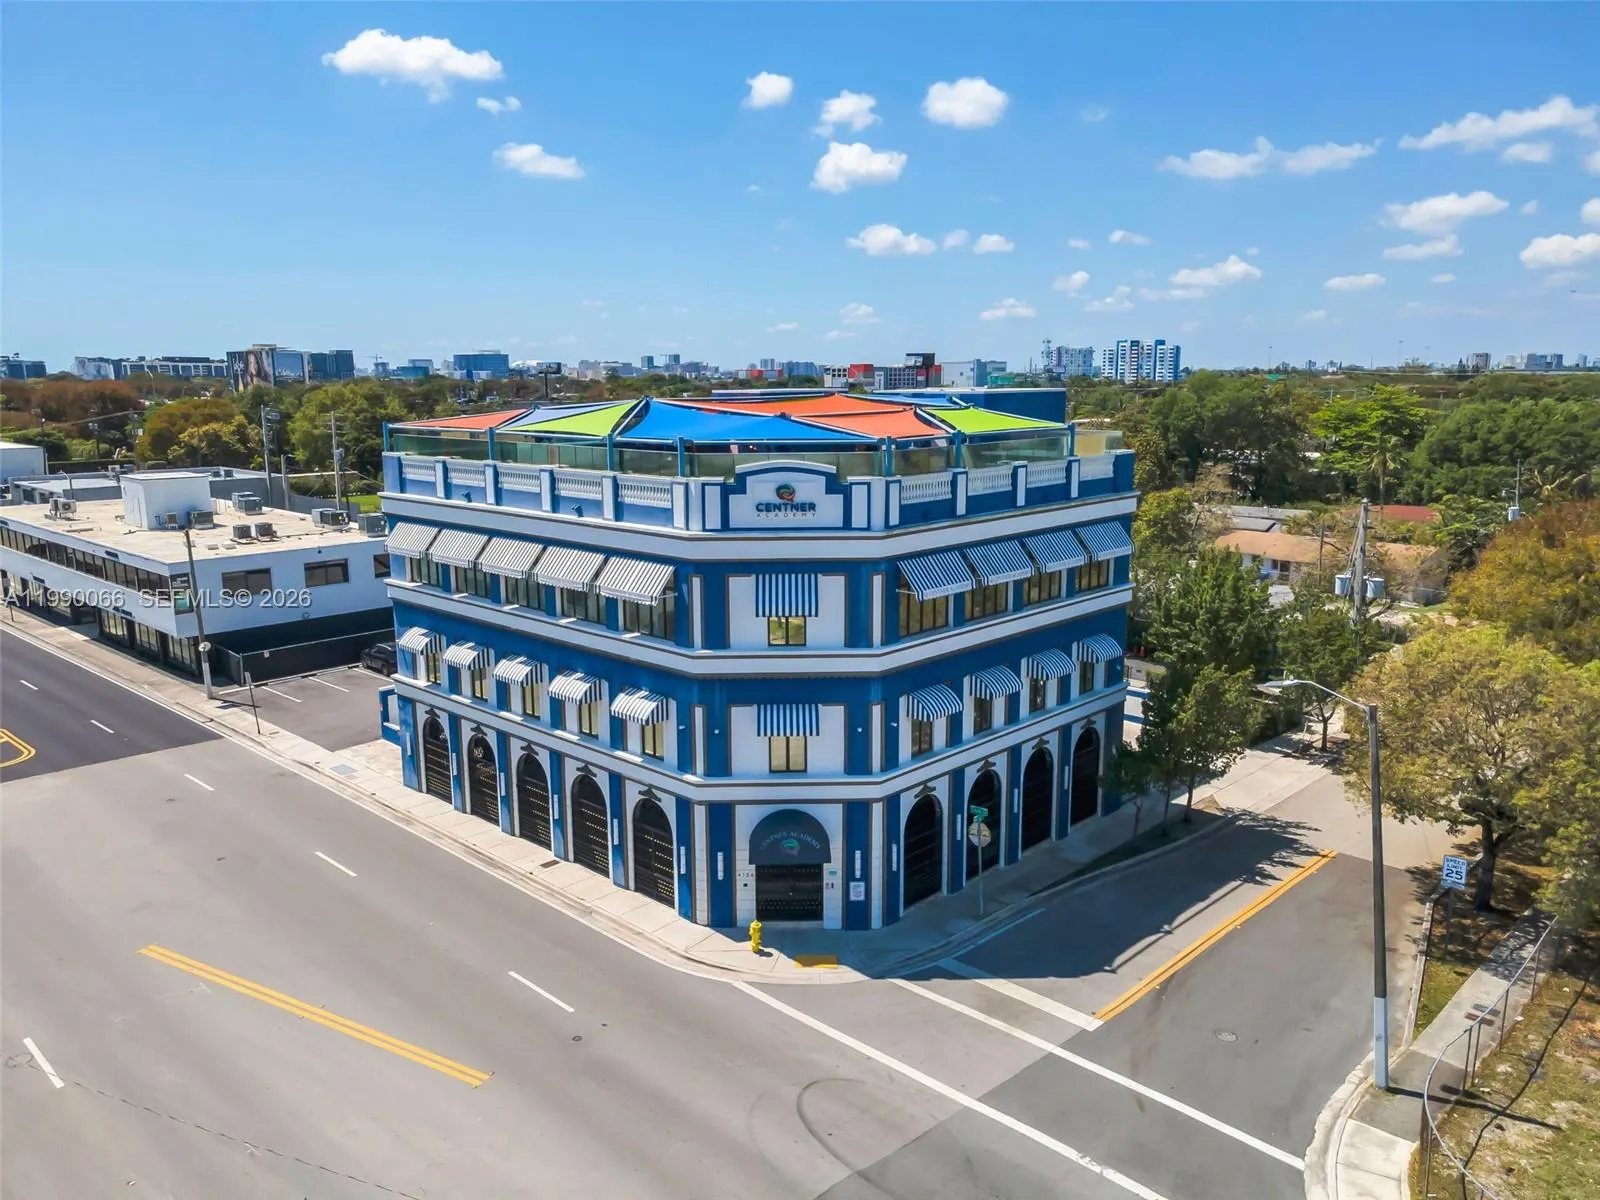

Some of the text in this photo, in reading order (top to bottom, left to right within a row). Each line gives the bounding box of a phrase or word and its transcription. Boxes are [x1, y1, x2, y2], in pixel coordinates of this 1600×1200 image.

[756, 502, 816, 512] CENTNER
[1446, 858, 1465, 866] SPEED
[1445, 868, 1463, 880] 25
